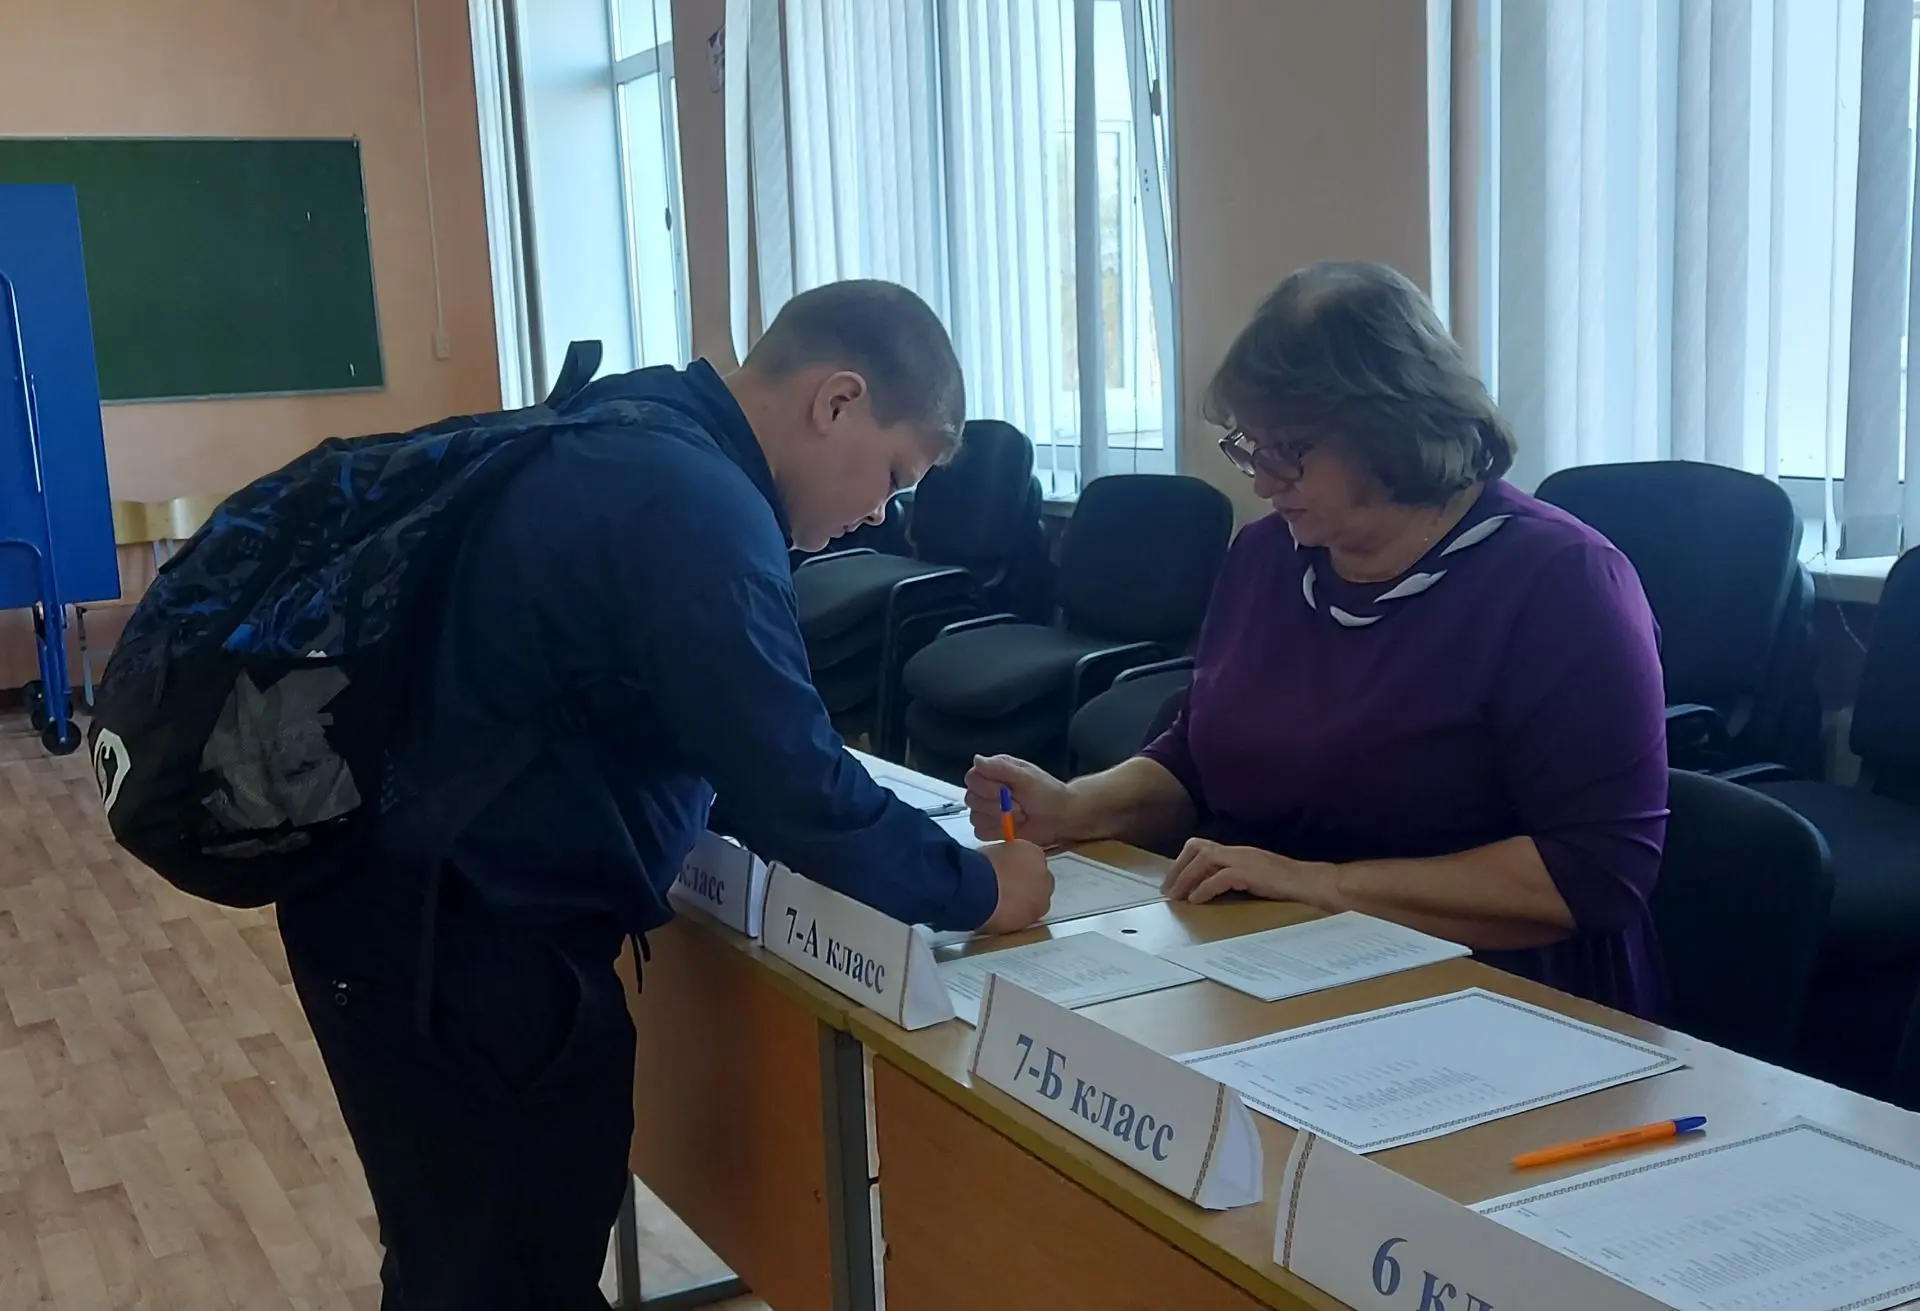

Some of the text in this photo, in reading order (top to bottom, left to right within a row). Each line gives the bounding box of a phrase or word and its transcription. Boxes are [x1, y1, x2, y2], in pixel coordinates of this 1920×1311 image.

[785, 906, 819, 960] 7-А
[825, 939, 886, 994] класс
[1013, 1033, 1067, 1101] 7-Б
[1069, 1078, 1174, 1162] класс
[1372, 1237, 1408, 1296] 6
